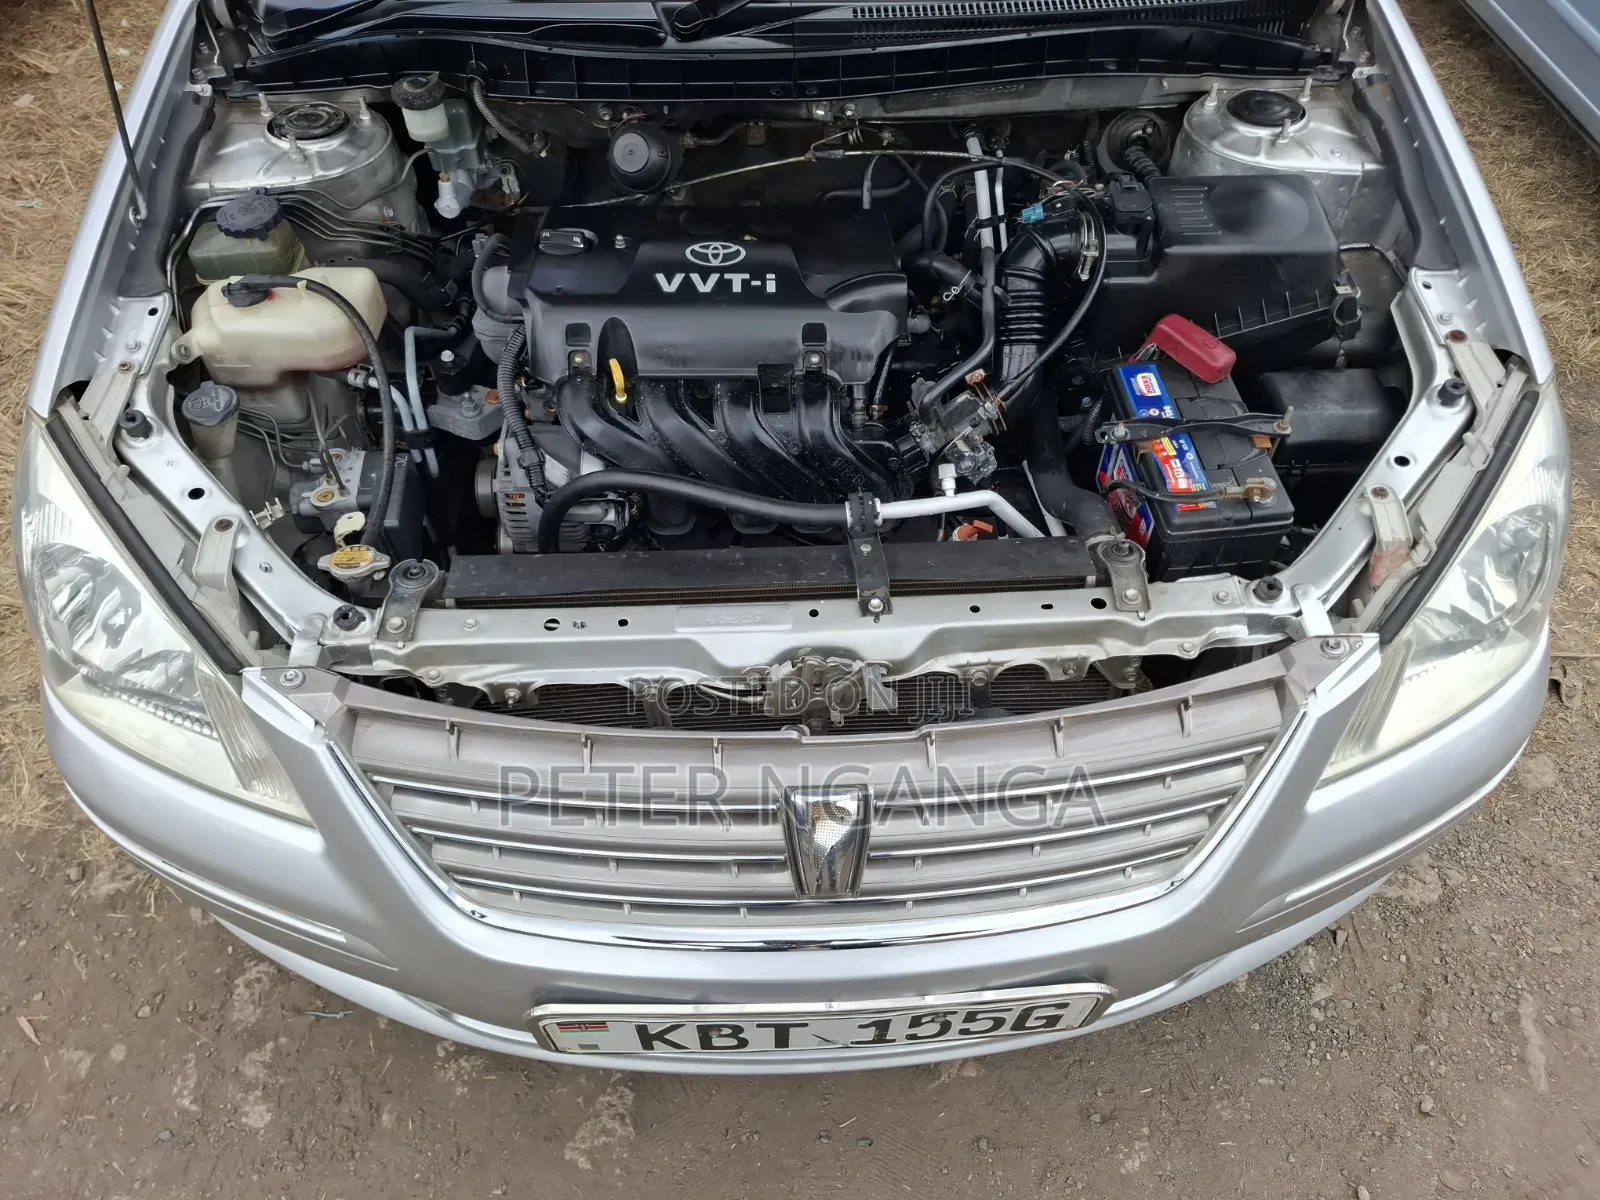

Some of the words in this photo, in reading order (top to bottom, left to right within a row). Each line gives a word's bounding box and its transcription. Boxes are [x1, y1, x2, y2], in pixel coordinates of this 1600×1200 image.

[655, 273, 777, 293] VVT-i
[1140, 375, 1153, 395] EXIDE
[636, 1021, 809, 1051] KBT
[849, 1002, 1072, 1046] 155G
